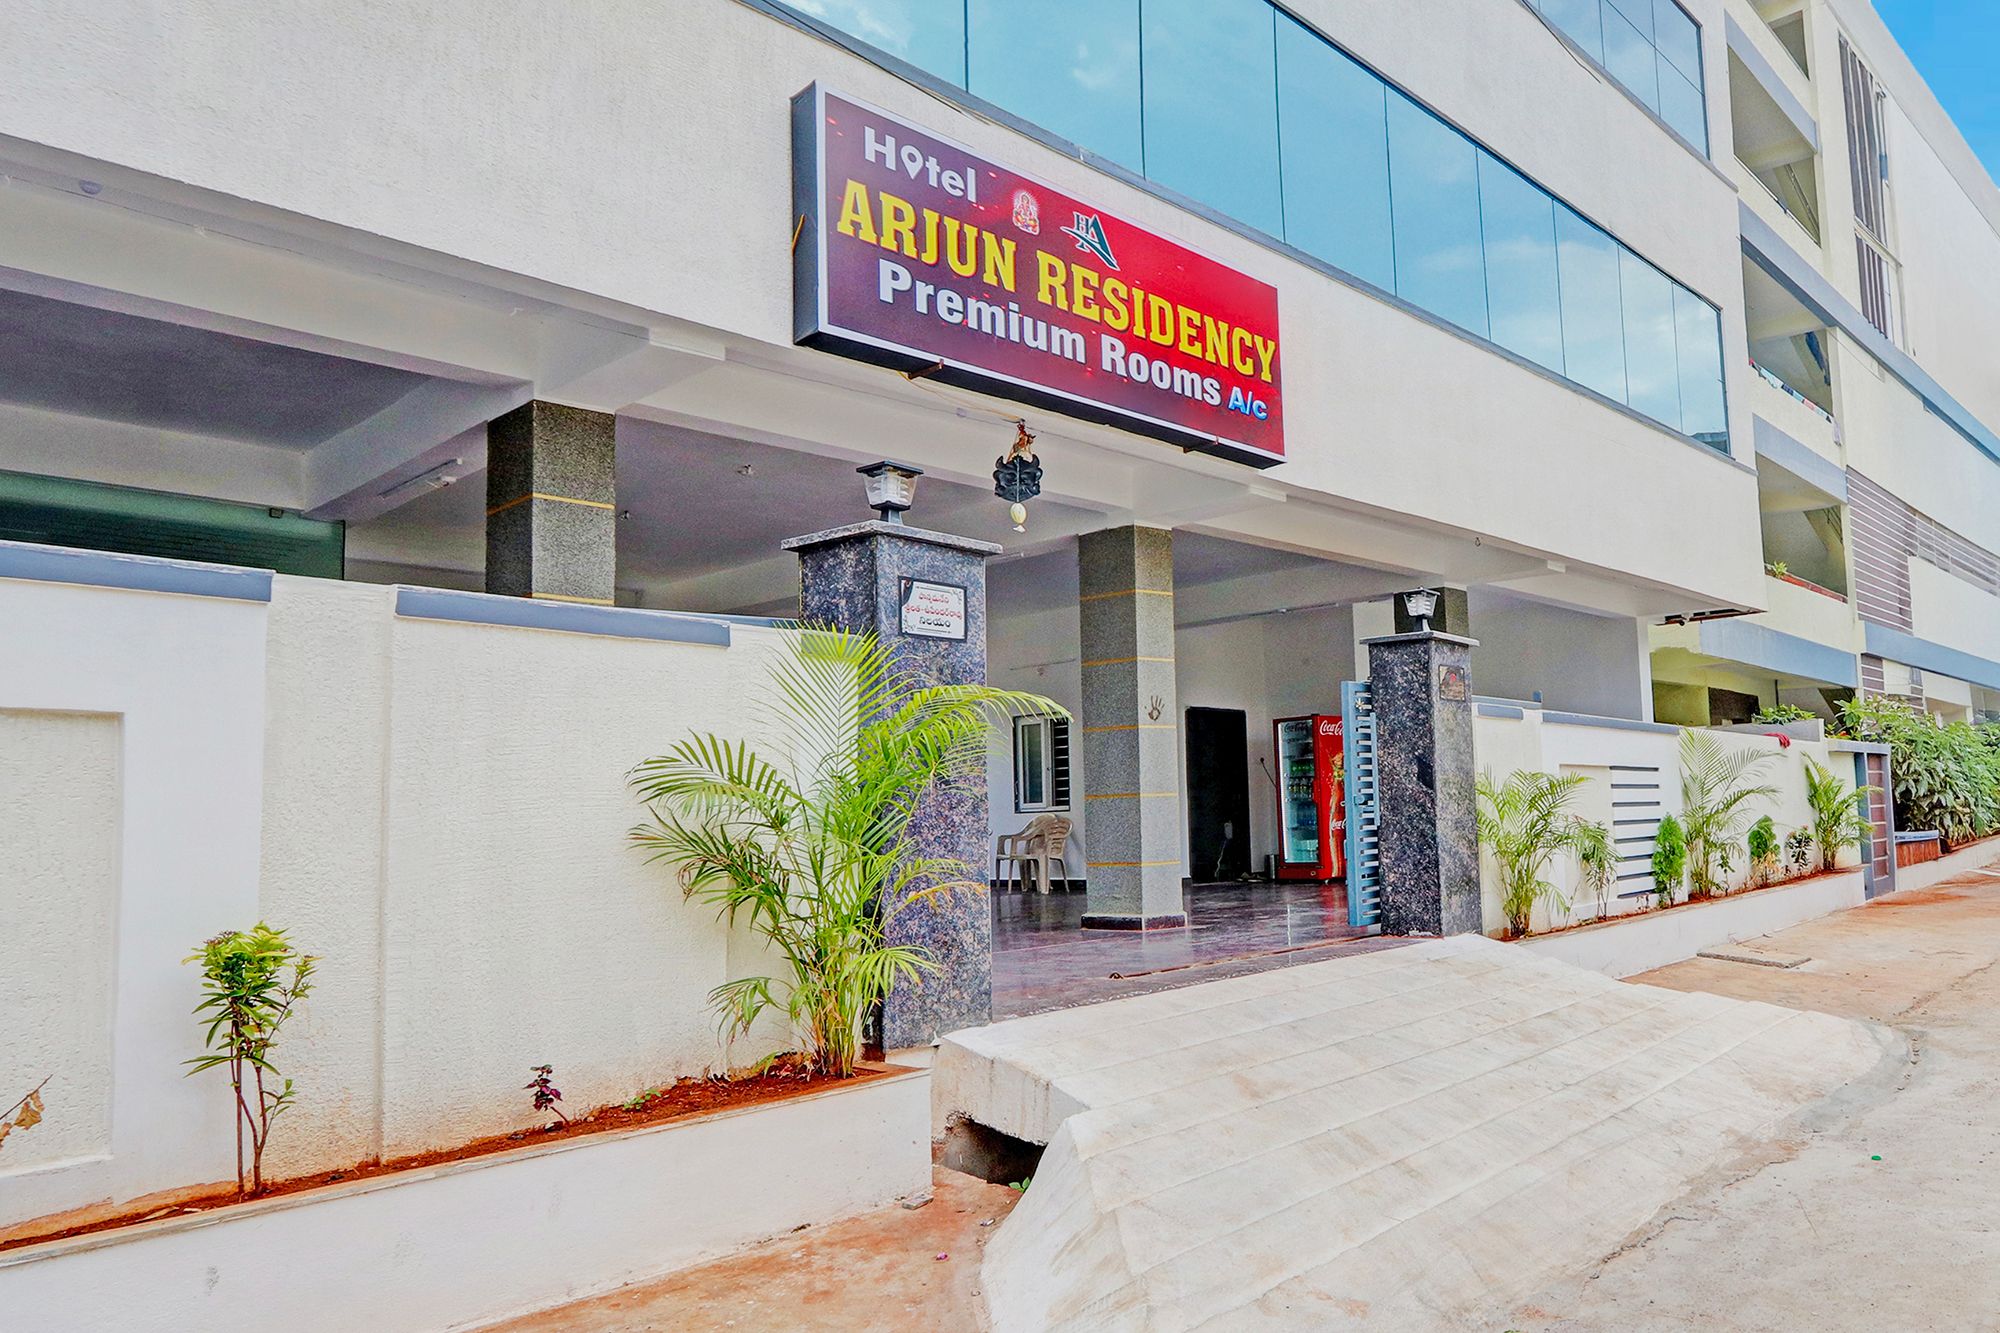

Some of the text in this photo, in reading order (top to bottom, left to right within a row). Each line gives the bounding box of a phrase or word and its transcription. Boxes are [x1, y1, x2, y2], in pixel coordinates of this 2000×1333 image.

[864, 126, 976, 203] Hotel
[838, 179, 1276, 383] ARJUN RESIDENCY
[879, 258, 1086, 364] Premium
[1101, 334, 1221, 406] Rooms
[919, 616, 951, 628] నిలయం
